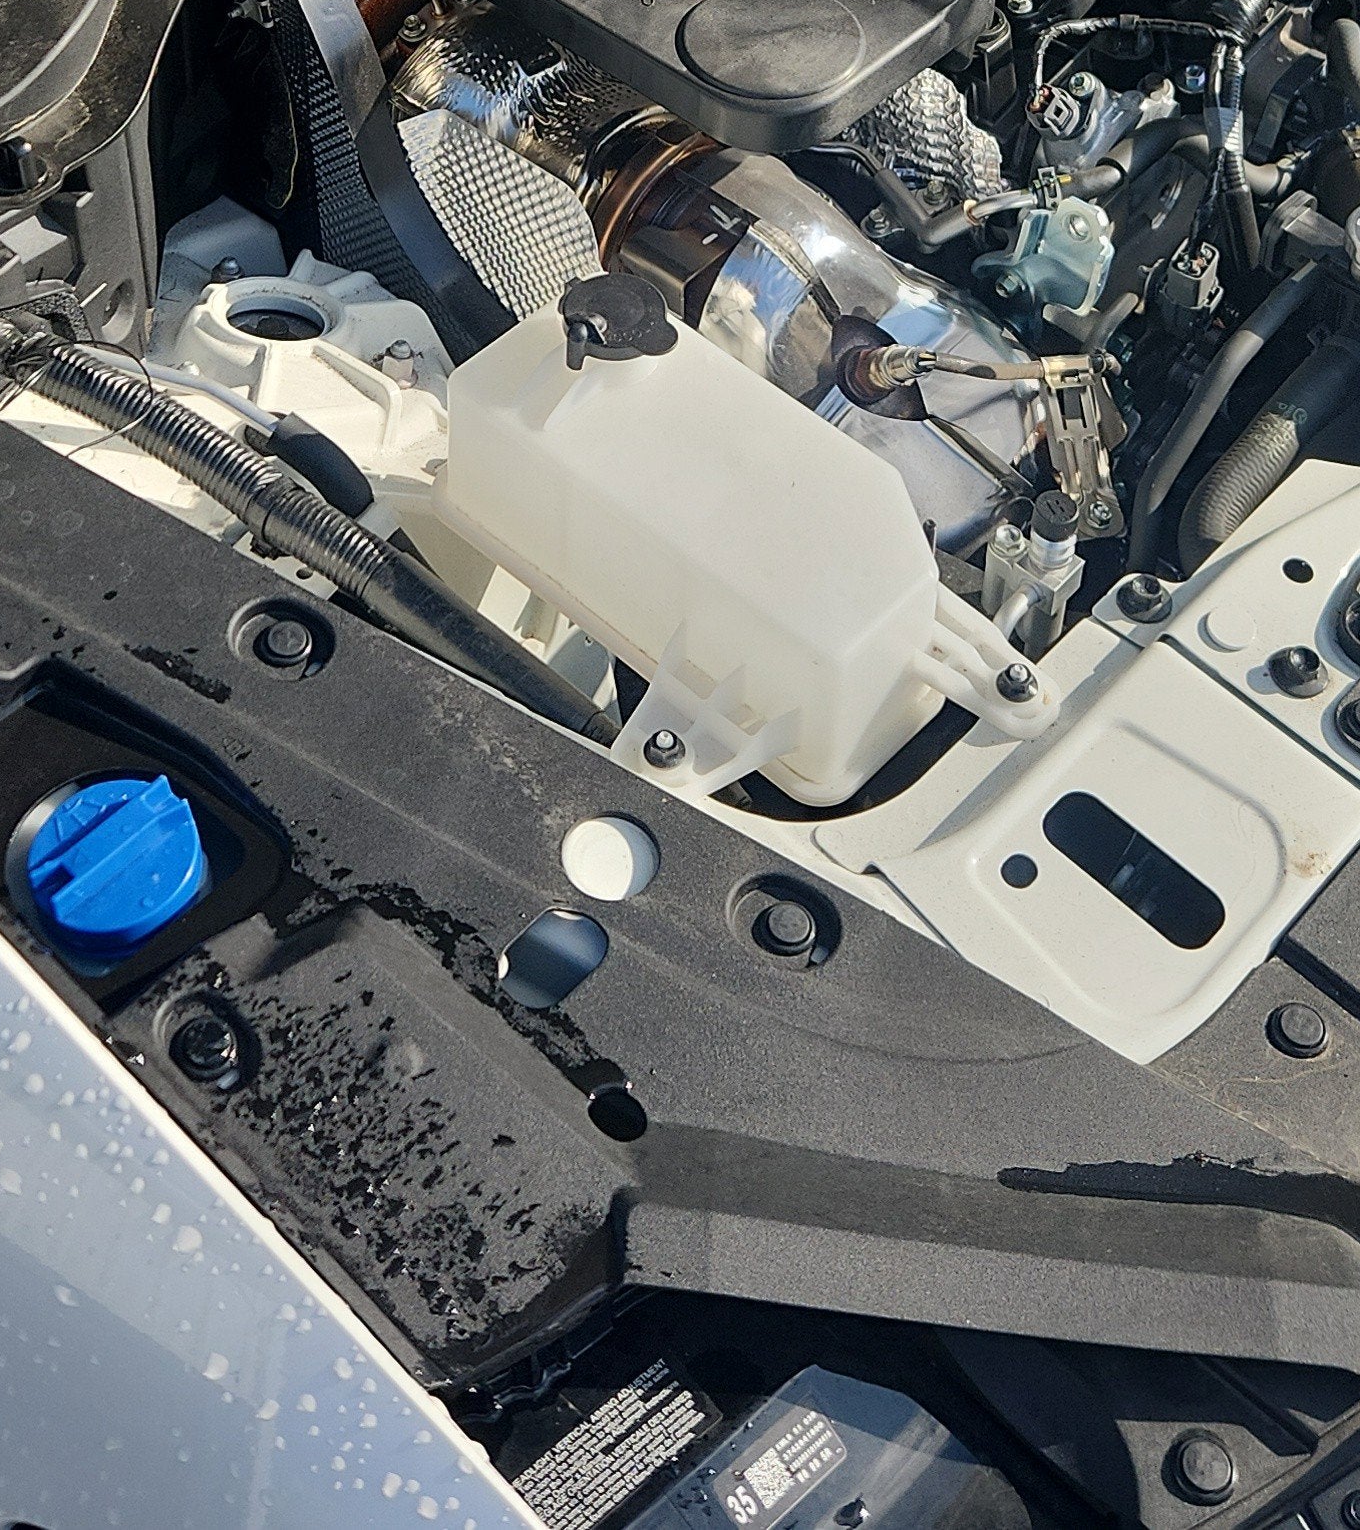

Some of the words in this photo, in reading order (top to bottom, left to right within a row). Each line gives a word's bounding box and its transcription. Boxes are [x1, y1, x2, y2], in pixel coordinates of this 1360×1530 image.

[552, 1422, 591, 1453] VERTICAL
[590, 1398, 619, 1423] AIMING
[617, 1359, 665, 1401] ADJUSTMENT
[539, 1493, 569, 1521] EGLAGE
[612, 1424, 650, 1457] VERTICALE
[727, 1486, 757, 1523] 35
